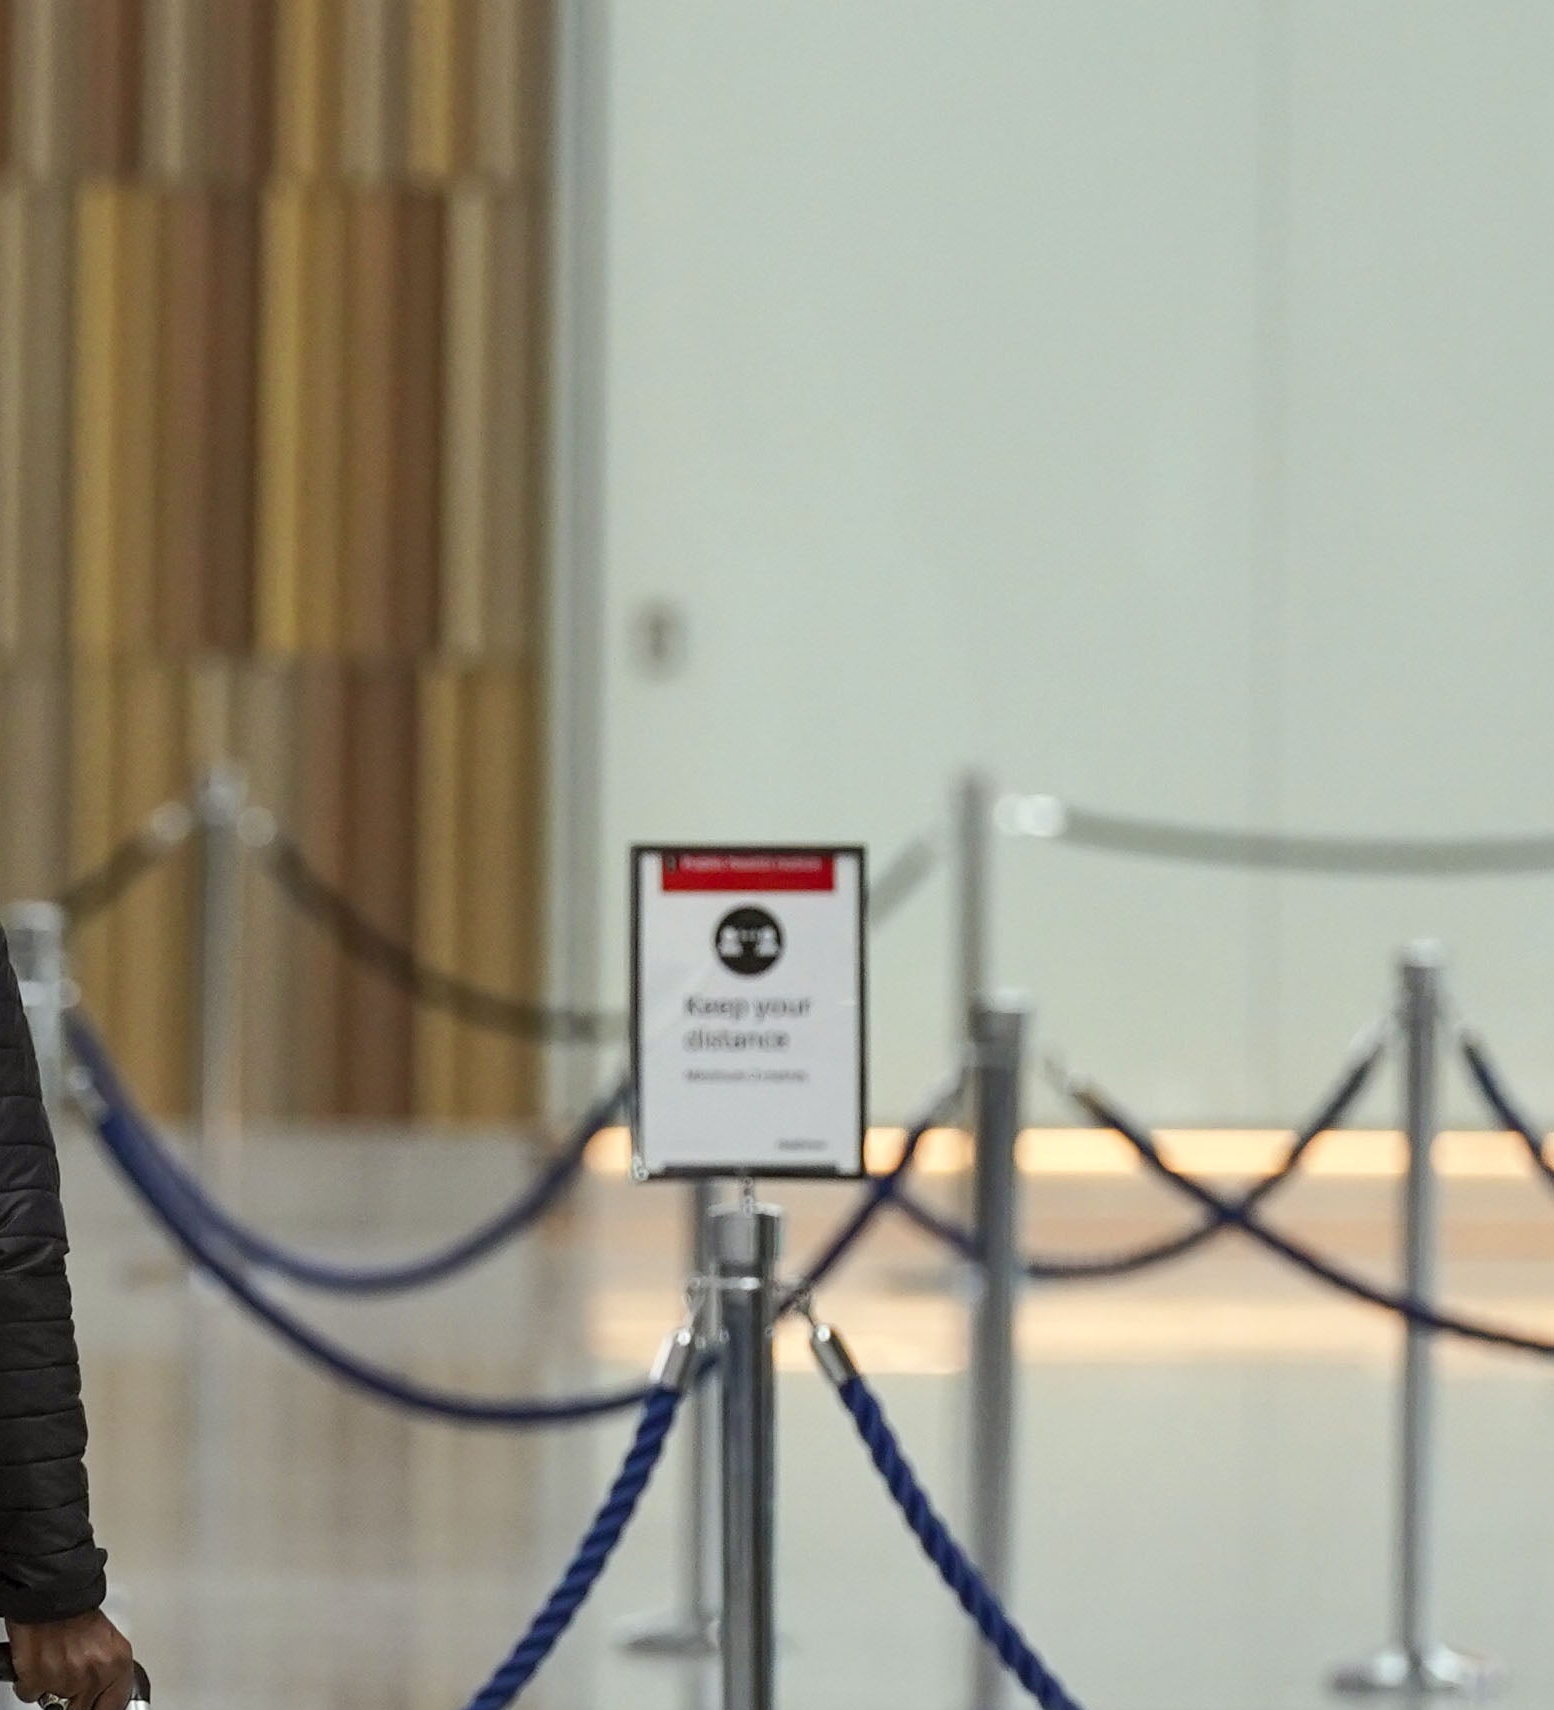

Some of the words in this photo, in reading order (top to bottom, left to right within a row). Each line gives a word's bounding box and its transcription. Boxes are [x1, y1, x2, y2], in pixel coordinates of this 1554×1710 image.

[686, 997, 749, 1020] Keep
[754, 999, 811, 1021] your
[686, 1029, 790, 1049] distance
